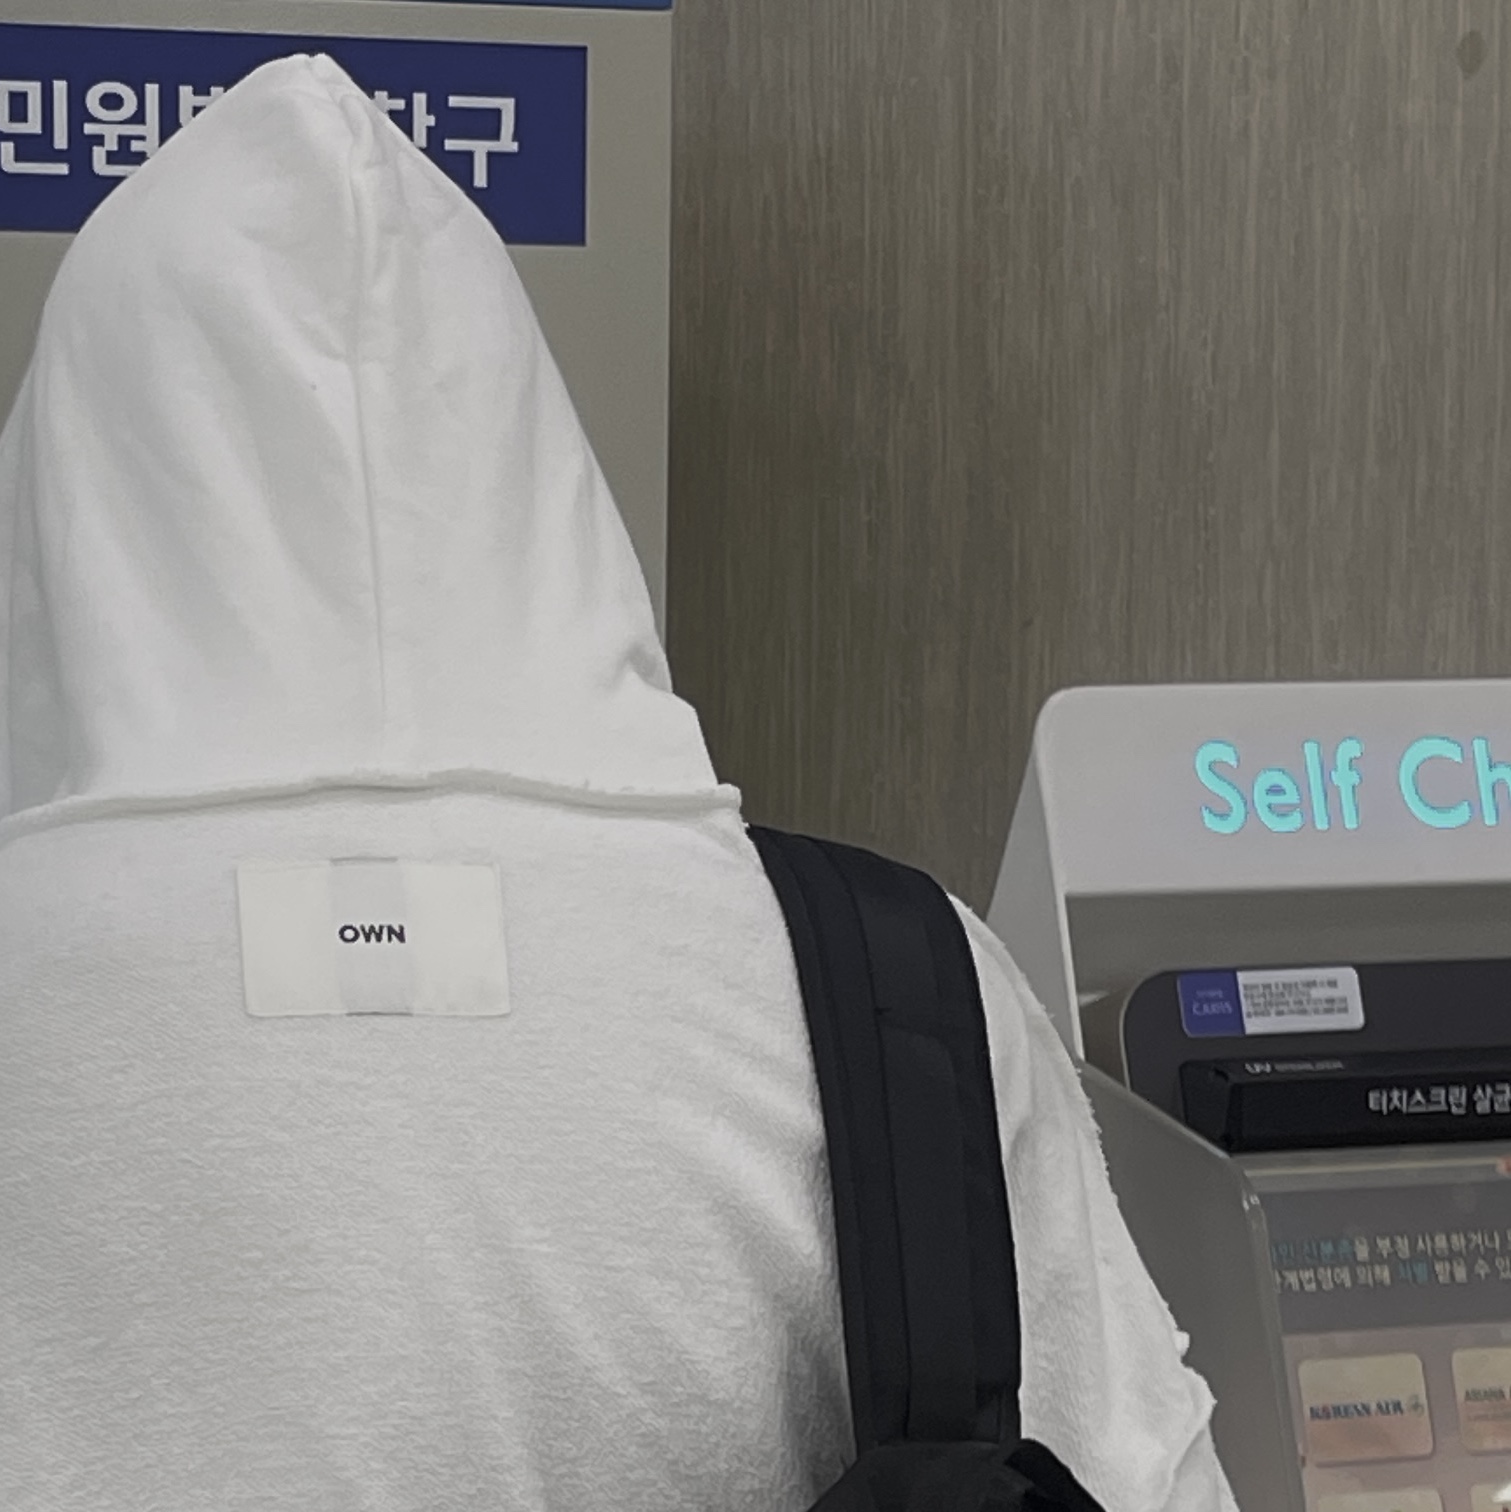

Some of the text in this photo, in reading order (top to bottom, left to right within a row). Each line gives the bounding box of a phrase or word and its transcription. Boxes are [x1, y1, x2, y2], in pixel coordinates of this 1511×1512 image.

[1194, 736, 1364, 834] Self
[338, 924, 406, 943] OWN
[1375, 1399, 1405, 1417] AIR
